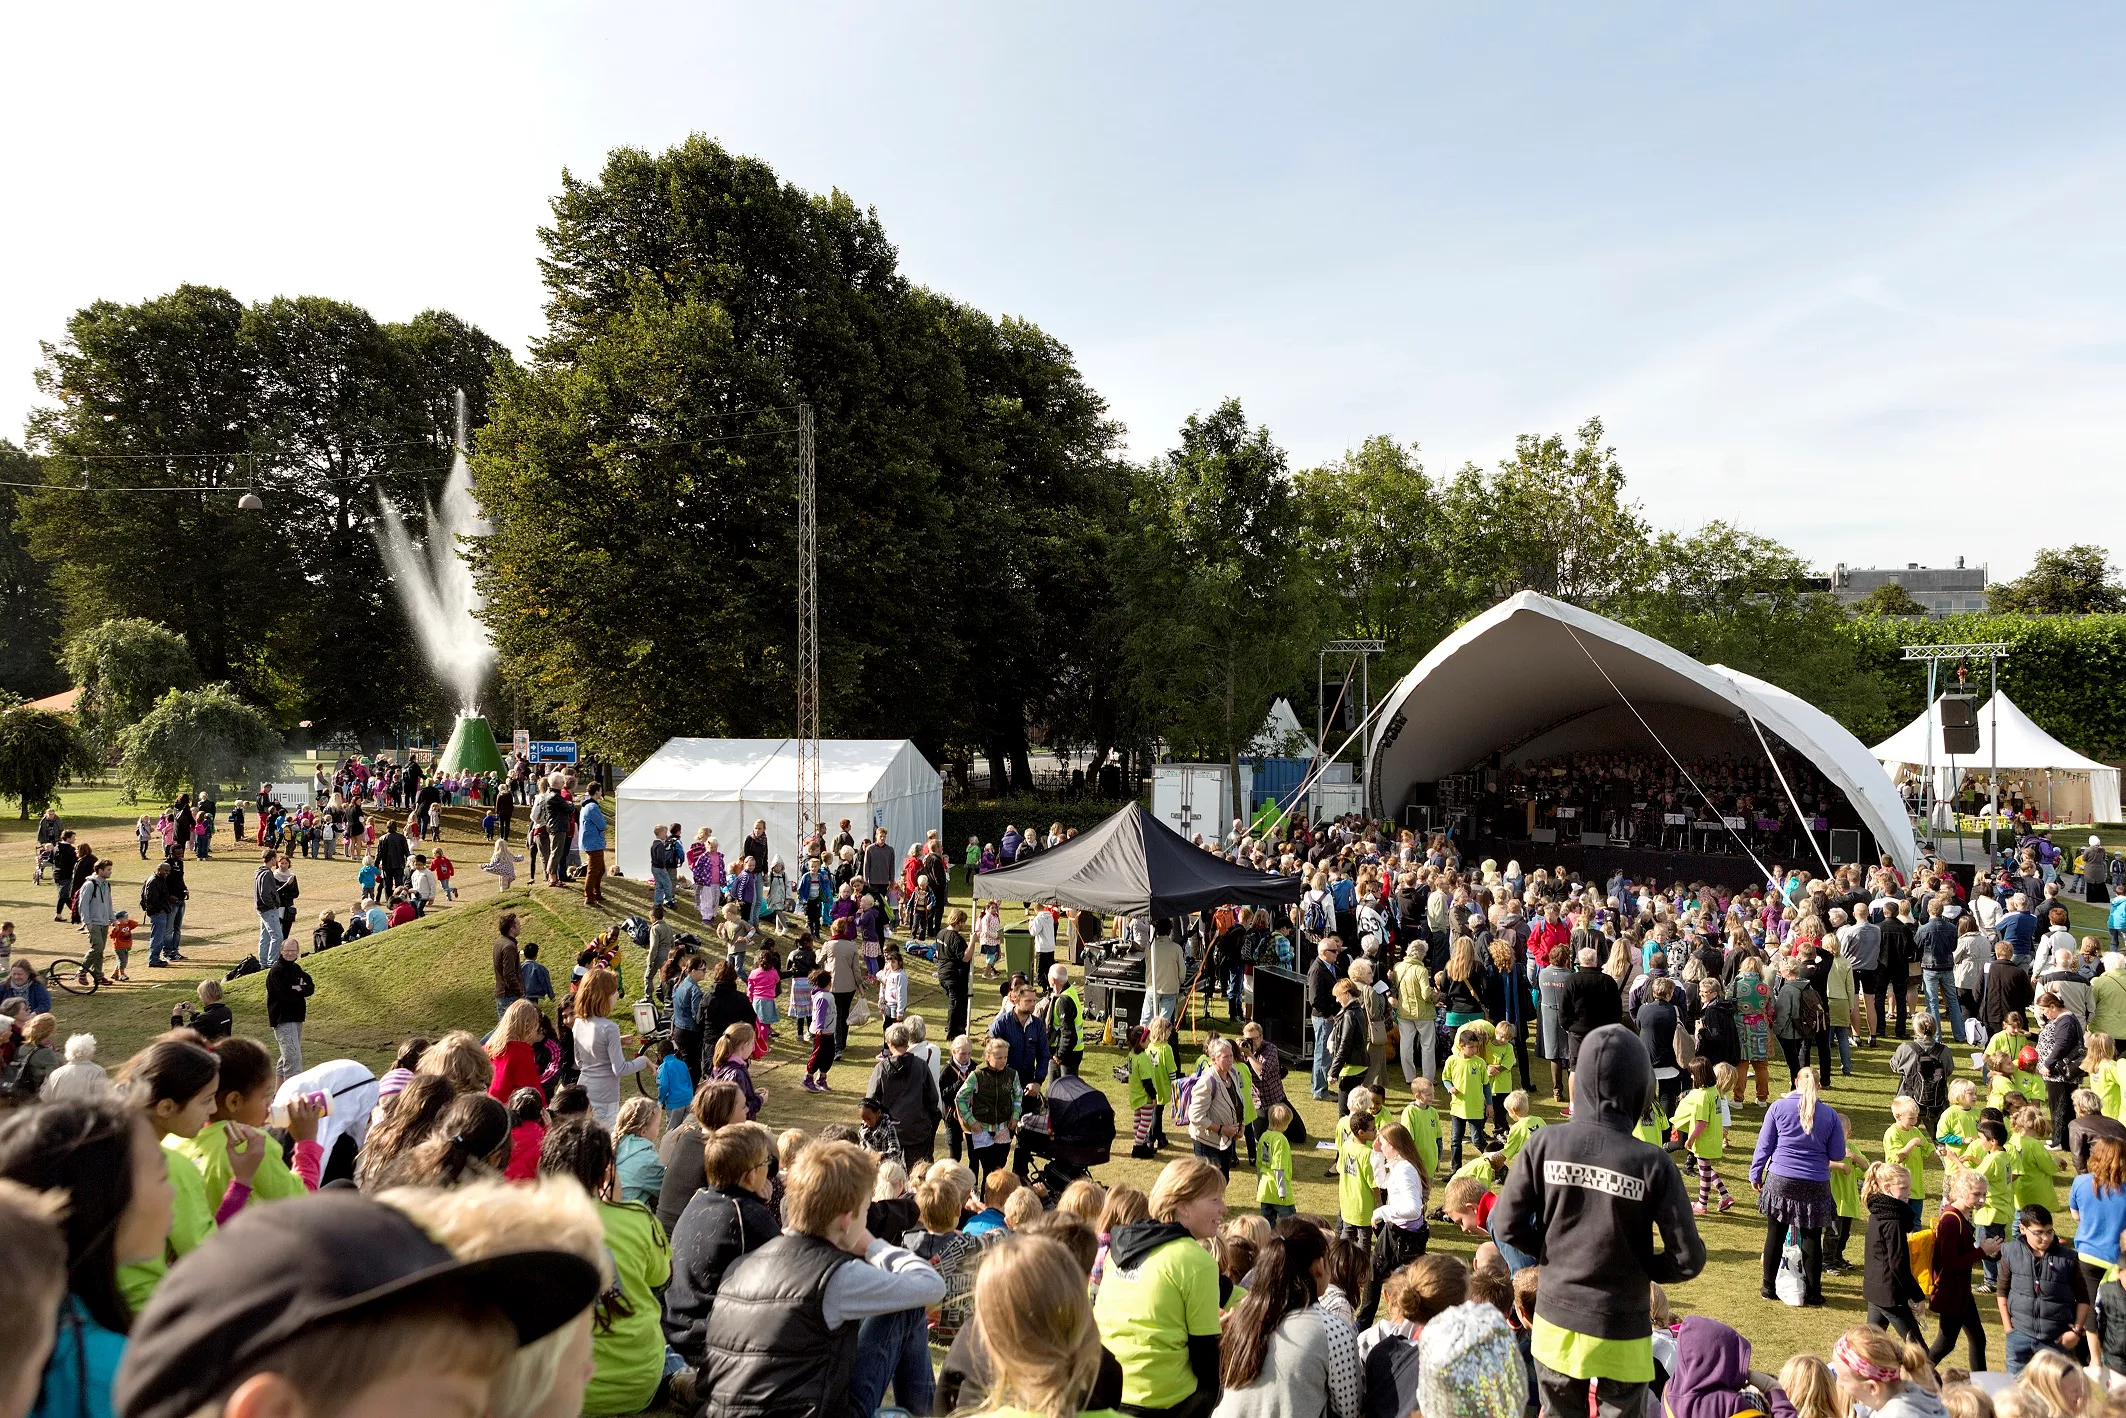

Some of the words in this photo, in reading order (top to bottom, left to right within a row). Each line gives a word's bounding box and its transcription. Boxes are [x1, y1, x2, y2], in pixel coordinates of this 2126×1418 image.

[540, 744, 554, 753] Scan
[555, 744, 575, 753] Center
[1545, 1161, 1644, 1200] NAPAPIJRI
